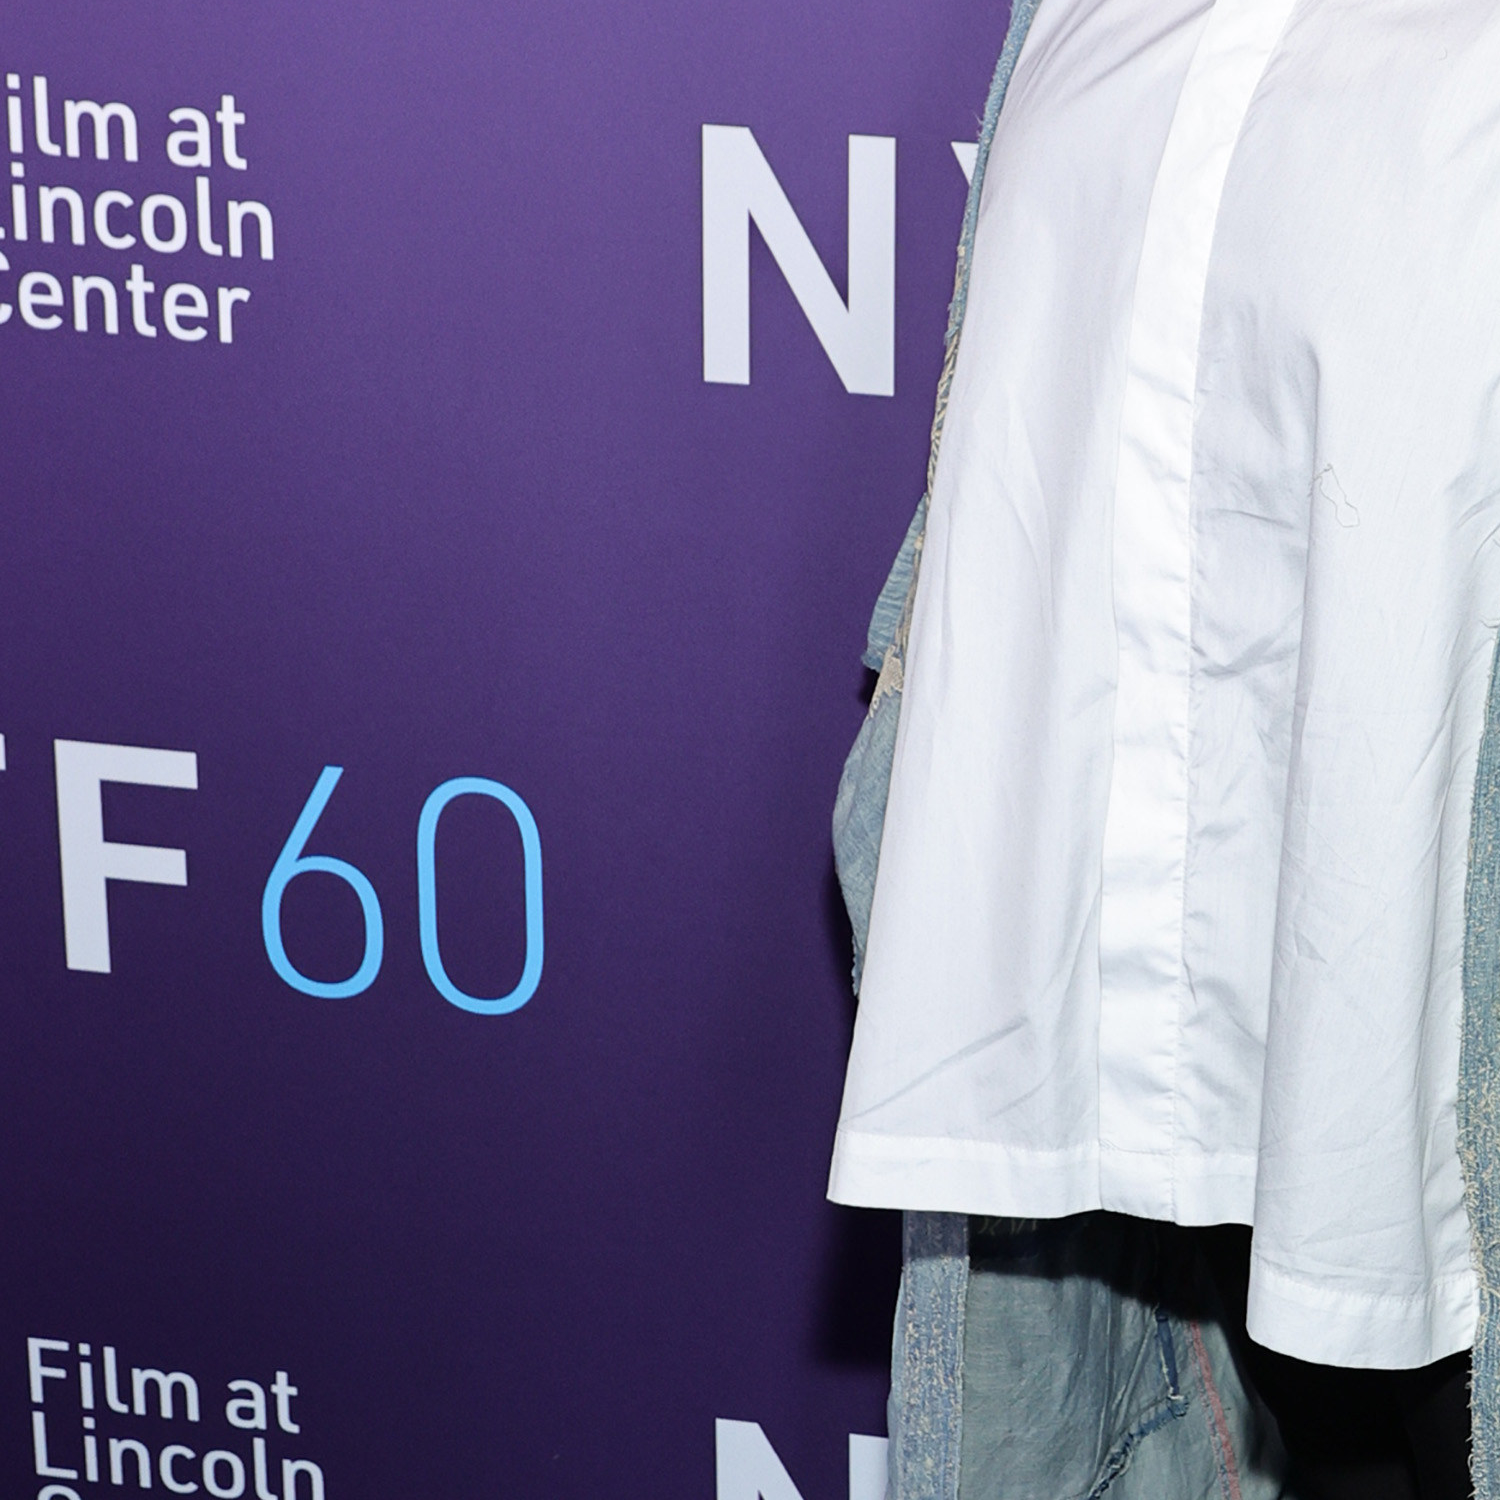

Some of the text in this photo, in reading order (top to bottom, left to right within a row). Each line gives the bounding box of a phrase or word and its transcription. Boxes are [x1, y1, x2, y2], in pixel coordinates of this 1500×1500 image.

[166, 94, 248, 171] at
[0, 161, 274, 261] incoln
[701, 123, 979, 397] N
[0, 251, 251, 344] enter
[0, 733, 544, 1015] F60
[27, 1336, 300, 1435] Film at
